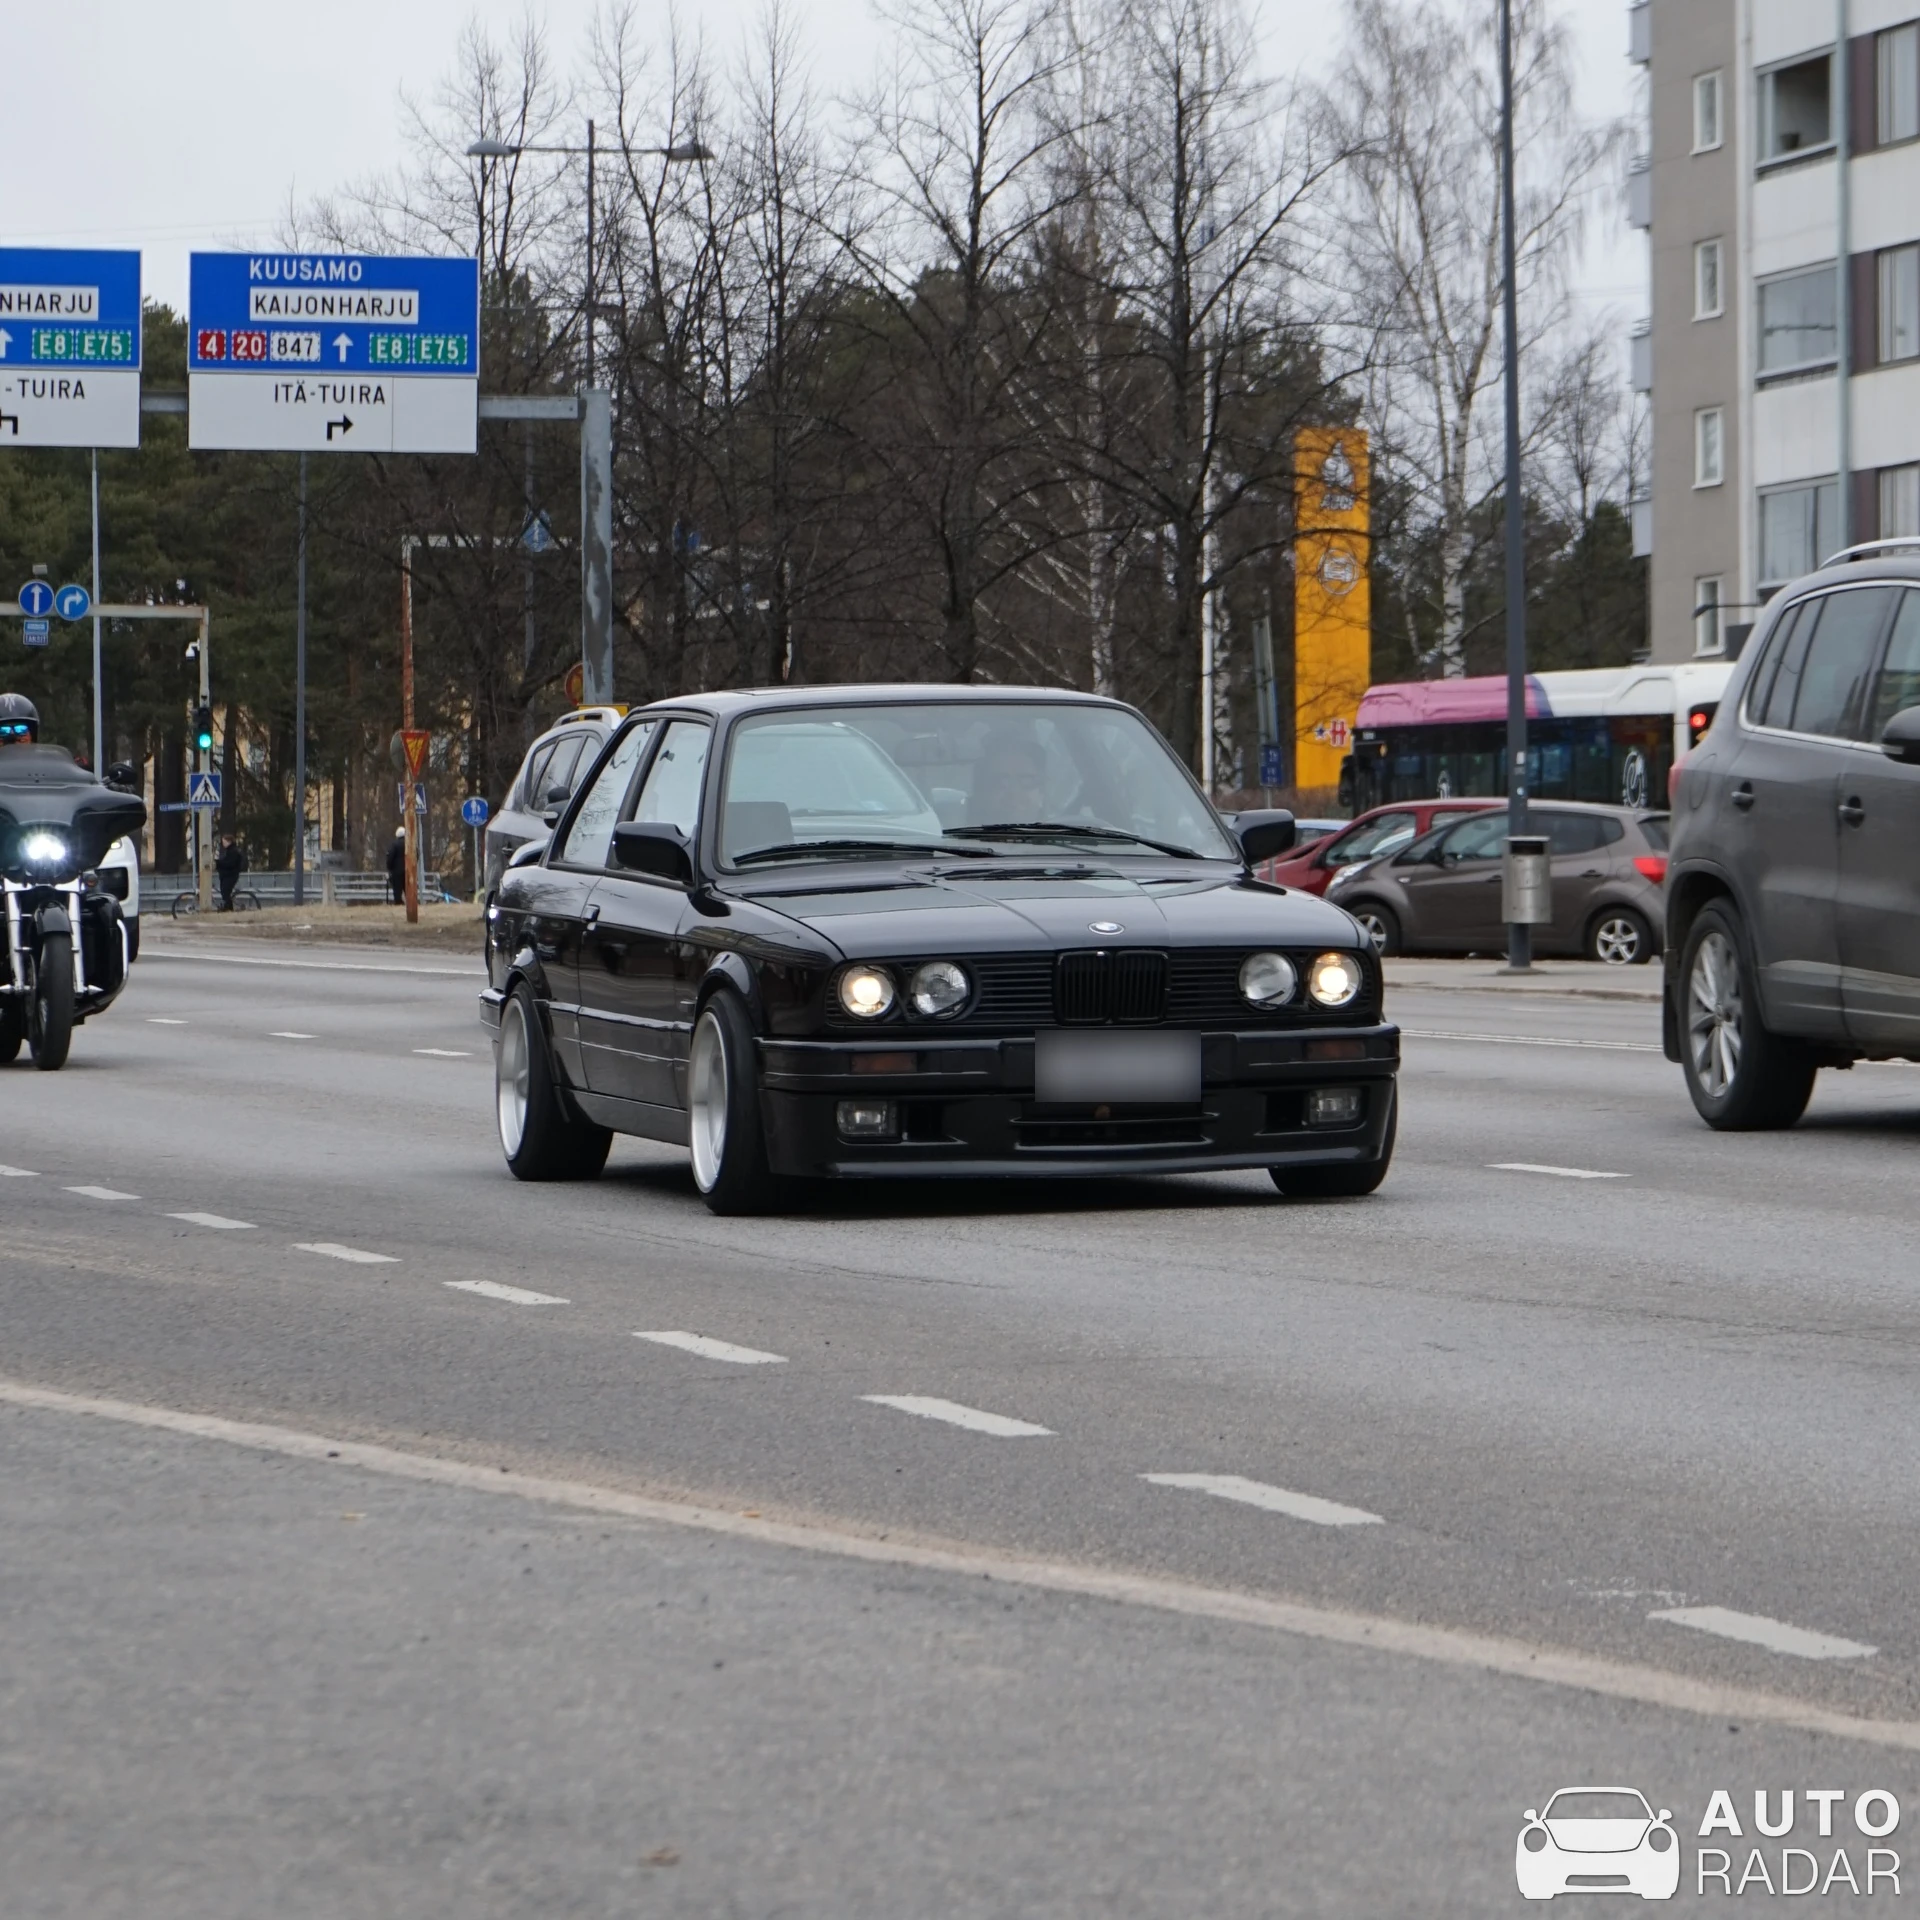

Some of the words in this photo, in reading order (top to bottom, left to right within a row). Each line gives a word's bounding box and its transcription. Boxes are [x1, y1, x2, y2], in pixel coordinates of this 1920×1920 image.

[249, 258, 363, 282] KUUSAMO
[0, 292, 93, 314] NHARJU
[254, 294, 413, 318] KAIJONHARJU
[39, 333, 67, 356] E8
[83, 334, 123, 357] E75
[205, 334, 218, 356] 4
[236, 335, 263, 357] 20
[277, 337, 314, 357] 847
[376, 338, 403, 360] E8
[420, 339, 459, 360] E75
[274, 380, 386, 405] ITÄ-TUIRA
